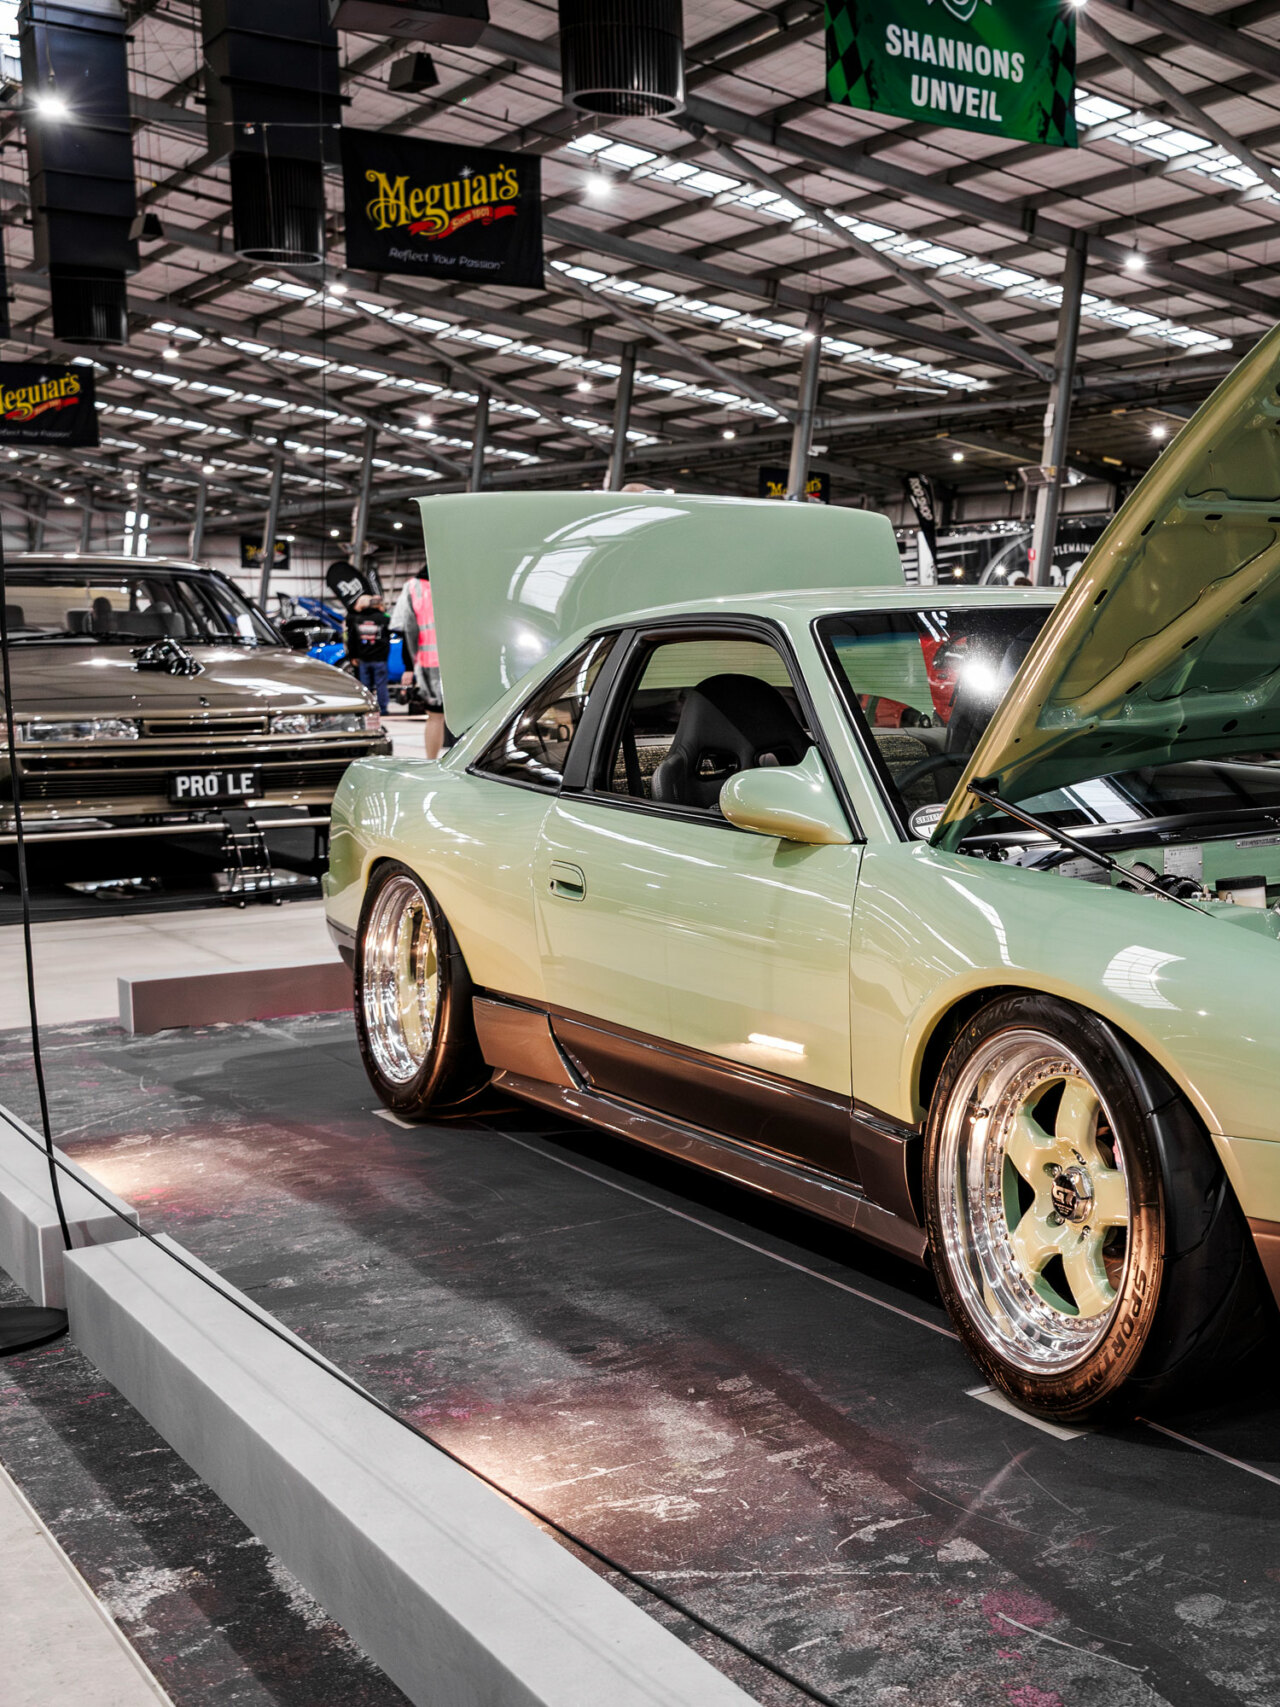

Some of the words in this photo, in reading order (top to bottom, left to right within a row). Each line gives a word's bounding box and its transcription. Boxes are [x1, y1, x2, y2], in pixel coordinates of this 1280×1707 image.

[885, 23, 1025, 83] SHANNONS
[910, 74, 1003, 122] UNVEIL
[365, 164, 520, 236] Meguiar's
[388, 248, 429, 262] Reflect
[433, 253, 457, 265] Your
[459, 256, 501, 270] Passion
[0, 372, 81, 420] eguiar's
[176, 774, 219, 798] PRO
[227, 772, 255, 795] LE
